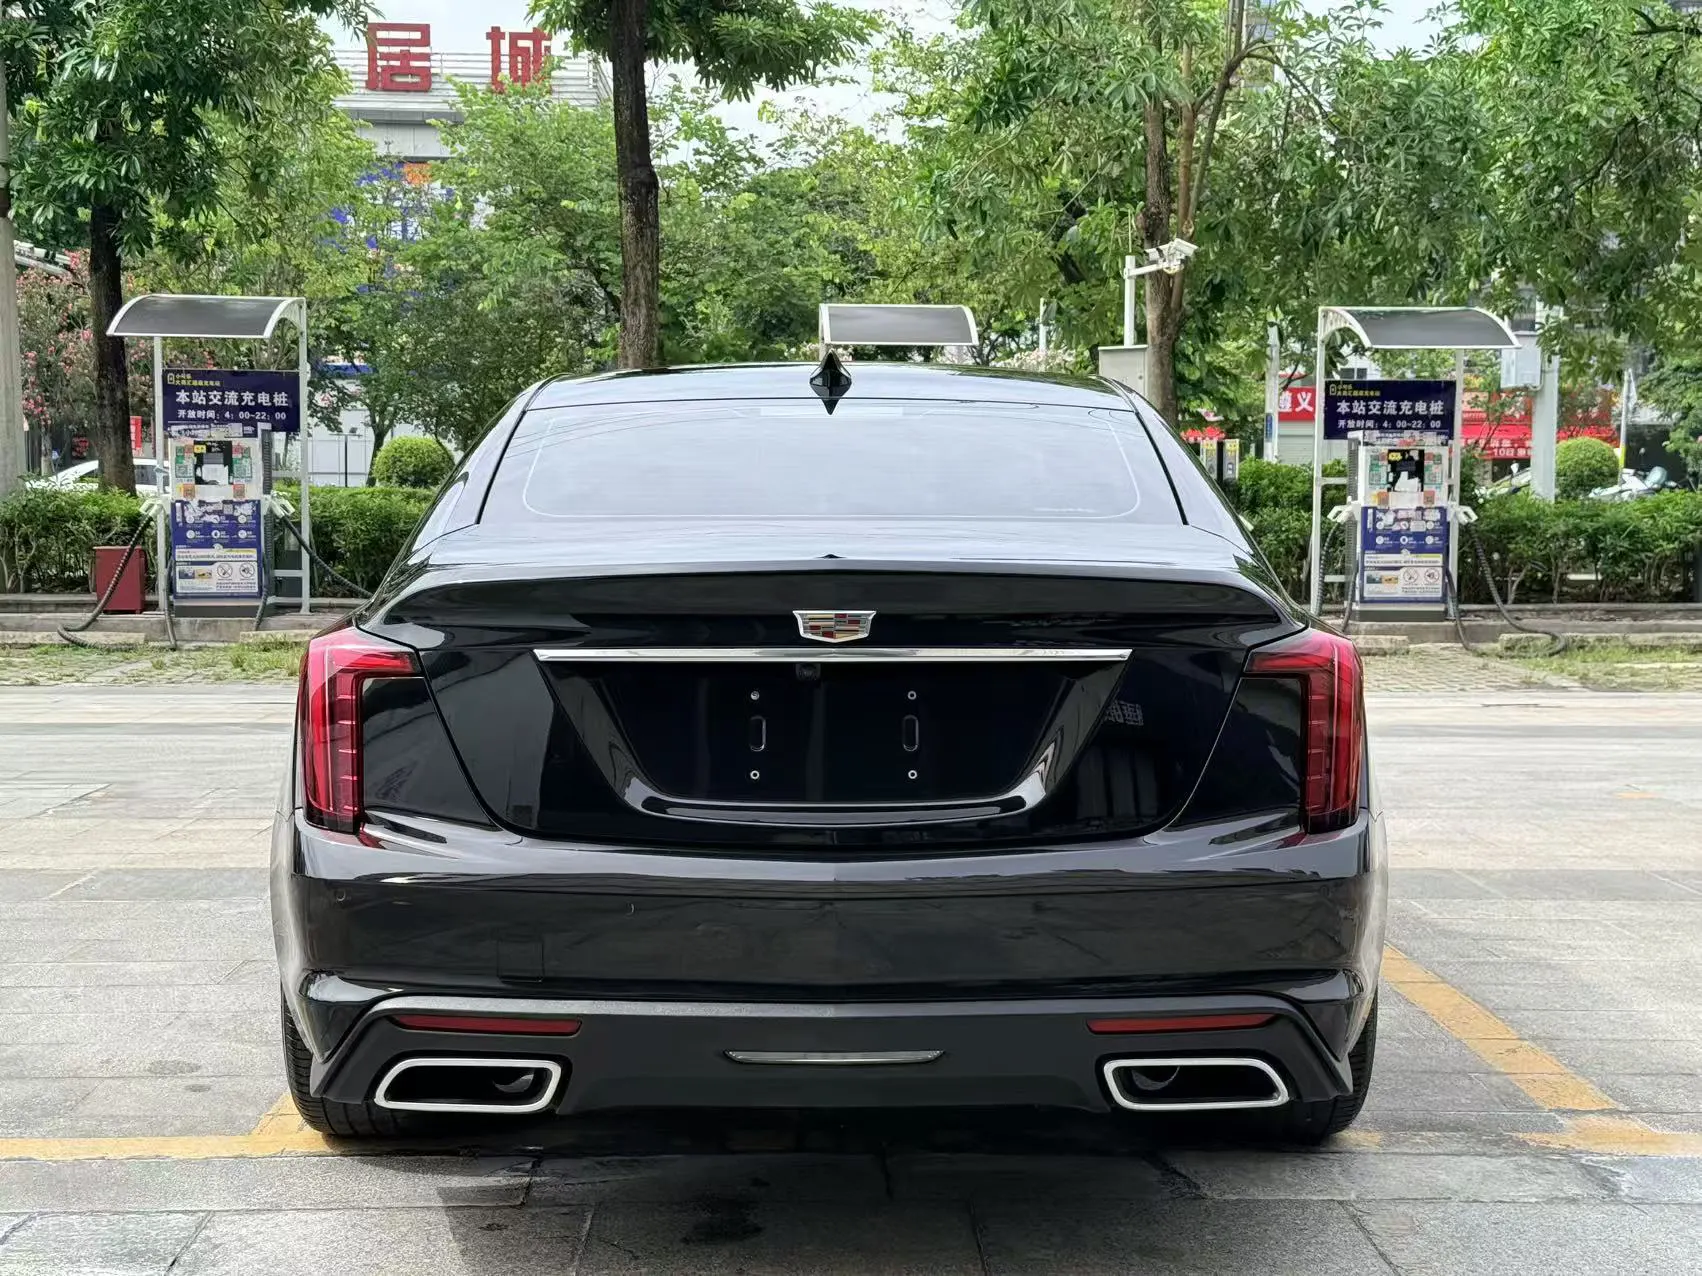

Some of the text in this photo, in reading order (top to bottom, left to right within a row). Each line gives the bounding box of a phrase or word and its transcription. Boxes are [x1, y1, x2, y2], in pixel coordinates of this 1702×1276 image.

[175, 389, 289, 406] 本站交流充电桩
[1336, 400, 1444, 415] 本站交流充电桩
